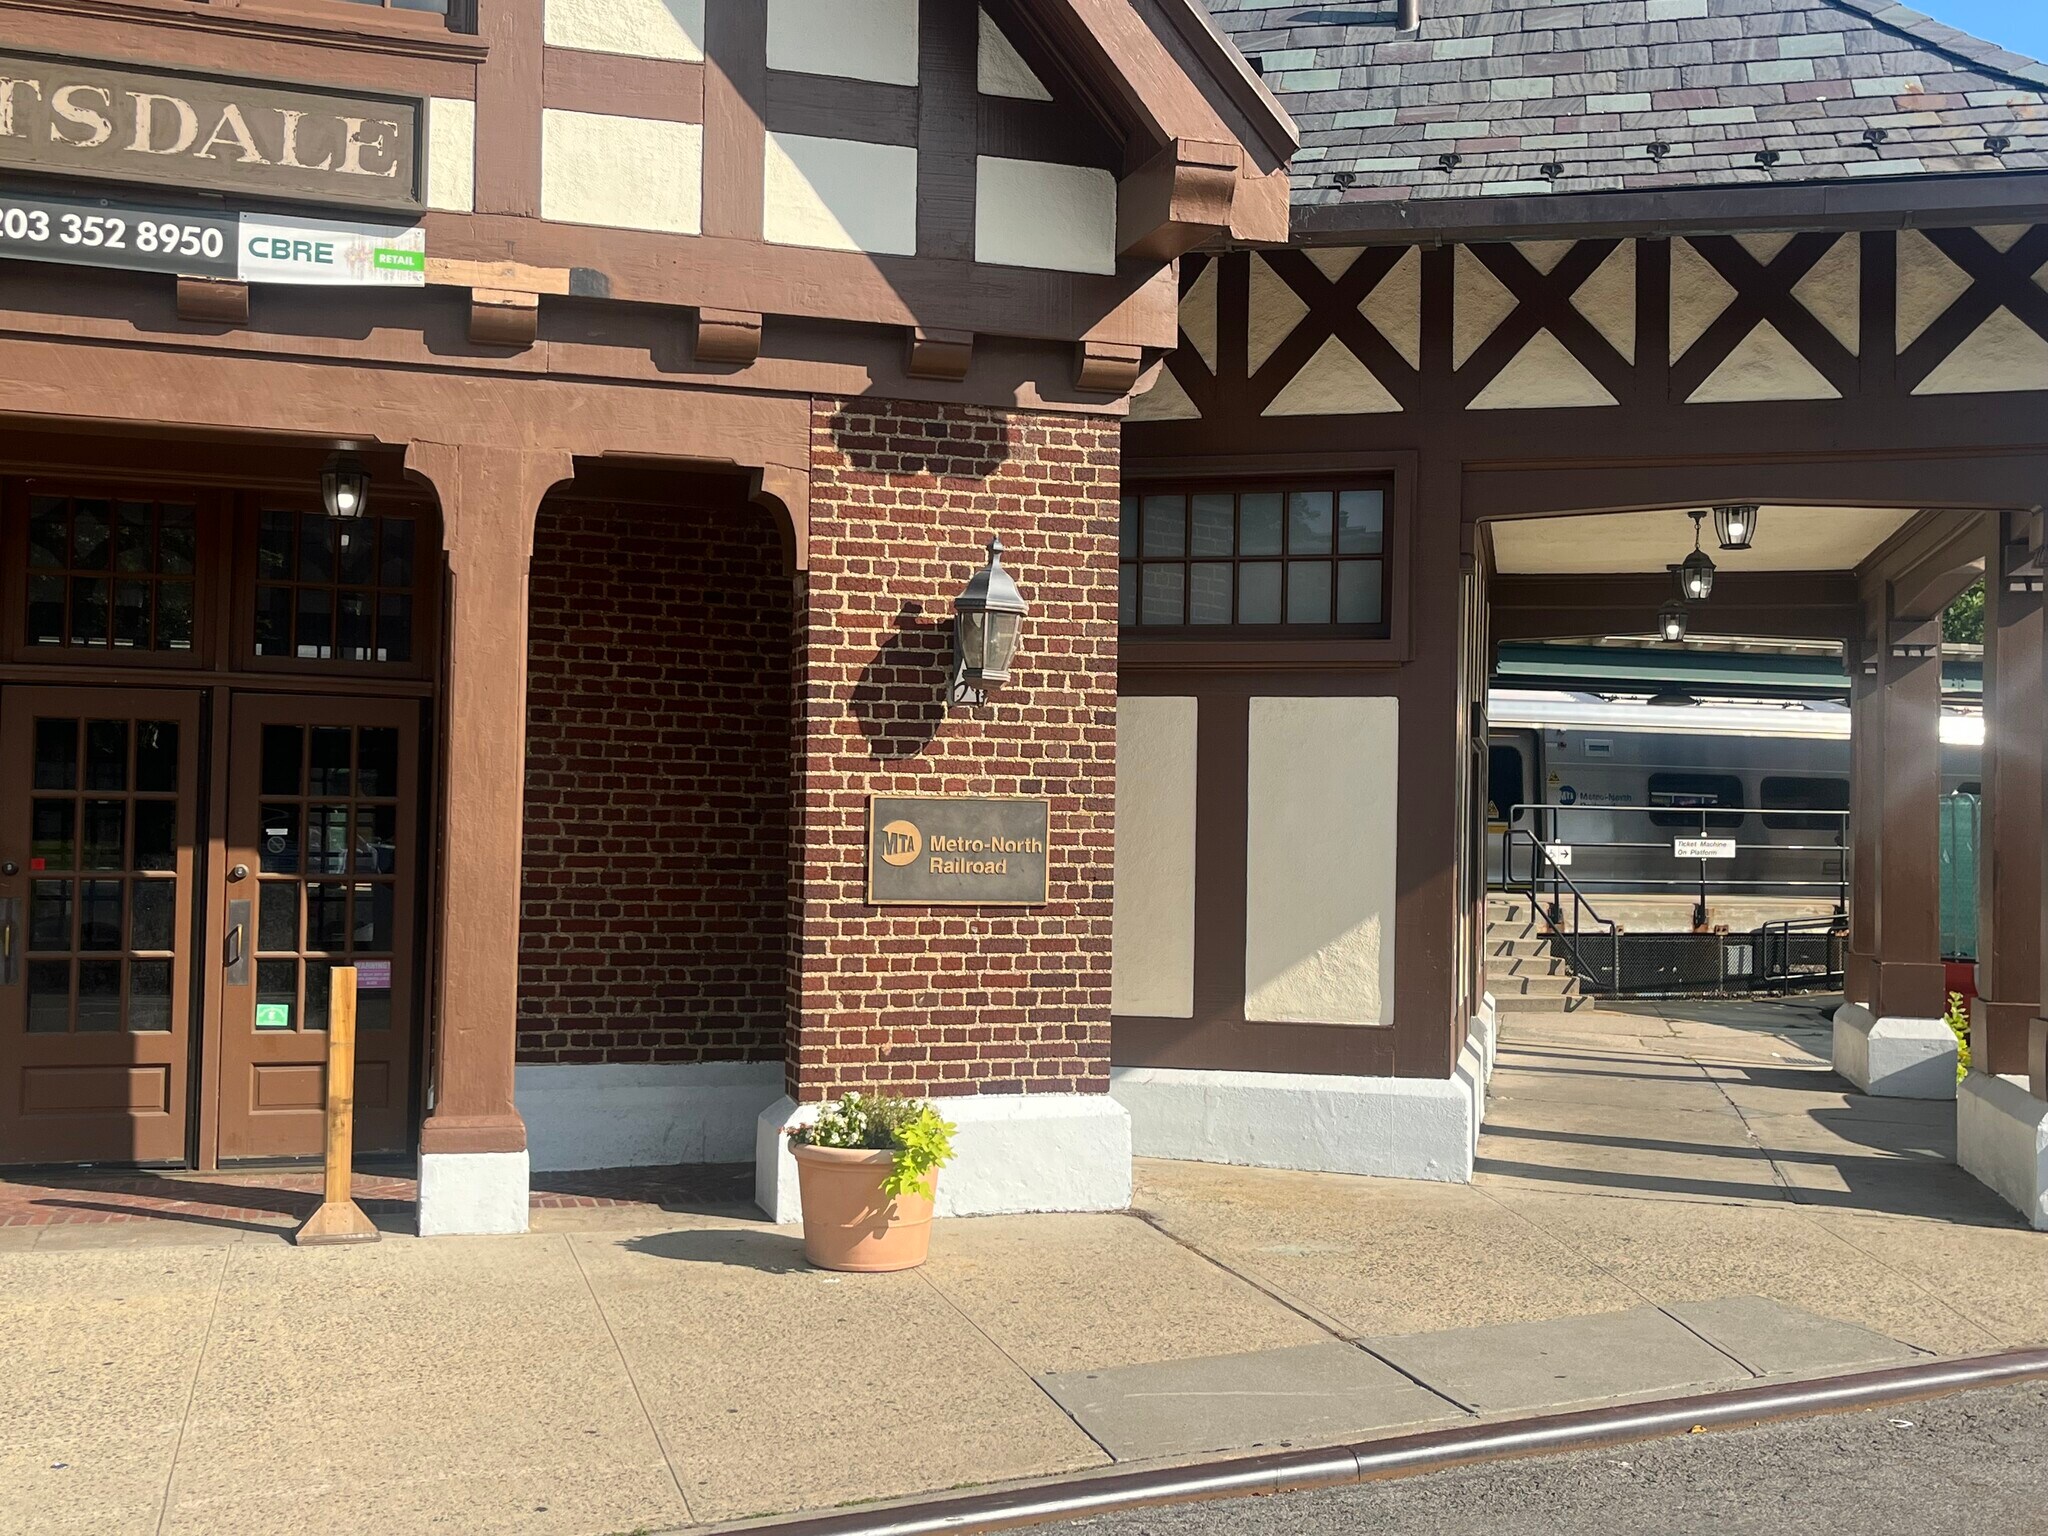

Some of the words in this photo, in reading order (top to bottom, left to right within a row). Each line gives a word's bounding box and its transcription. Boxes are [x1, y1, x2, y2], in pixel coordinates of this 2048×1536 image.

[0, 207, 50, 241] 03
[60, 213, 126, 249] 352
[136, 221, 224, 258] 8950
[248, 237, 334, 265] CBRE
[378, 253, 416, 267] RETAIL
[1579, 791, 1632, 802] Metro-North
[929, 835, 1043, 854] Metro-North
[1677, 839, 1697, 847] Ticket
[1700, 840, 1728, 848] Machine
[1690, 847, 1718, 855] Platform
[929, 857, 1008, 875] Railroad
